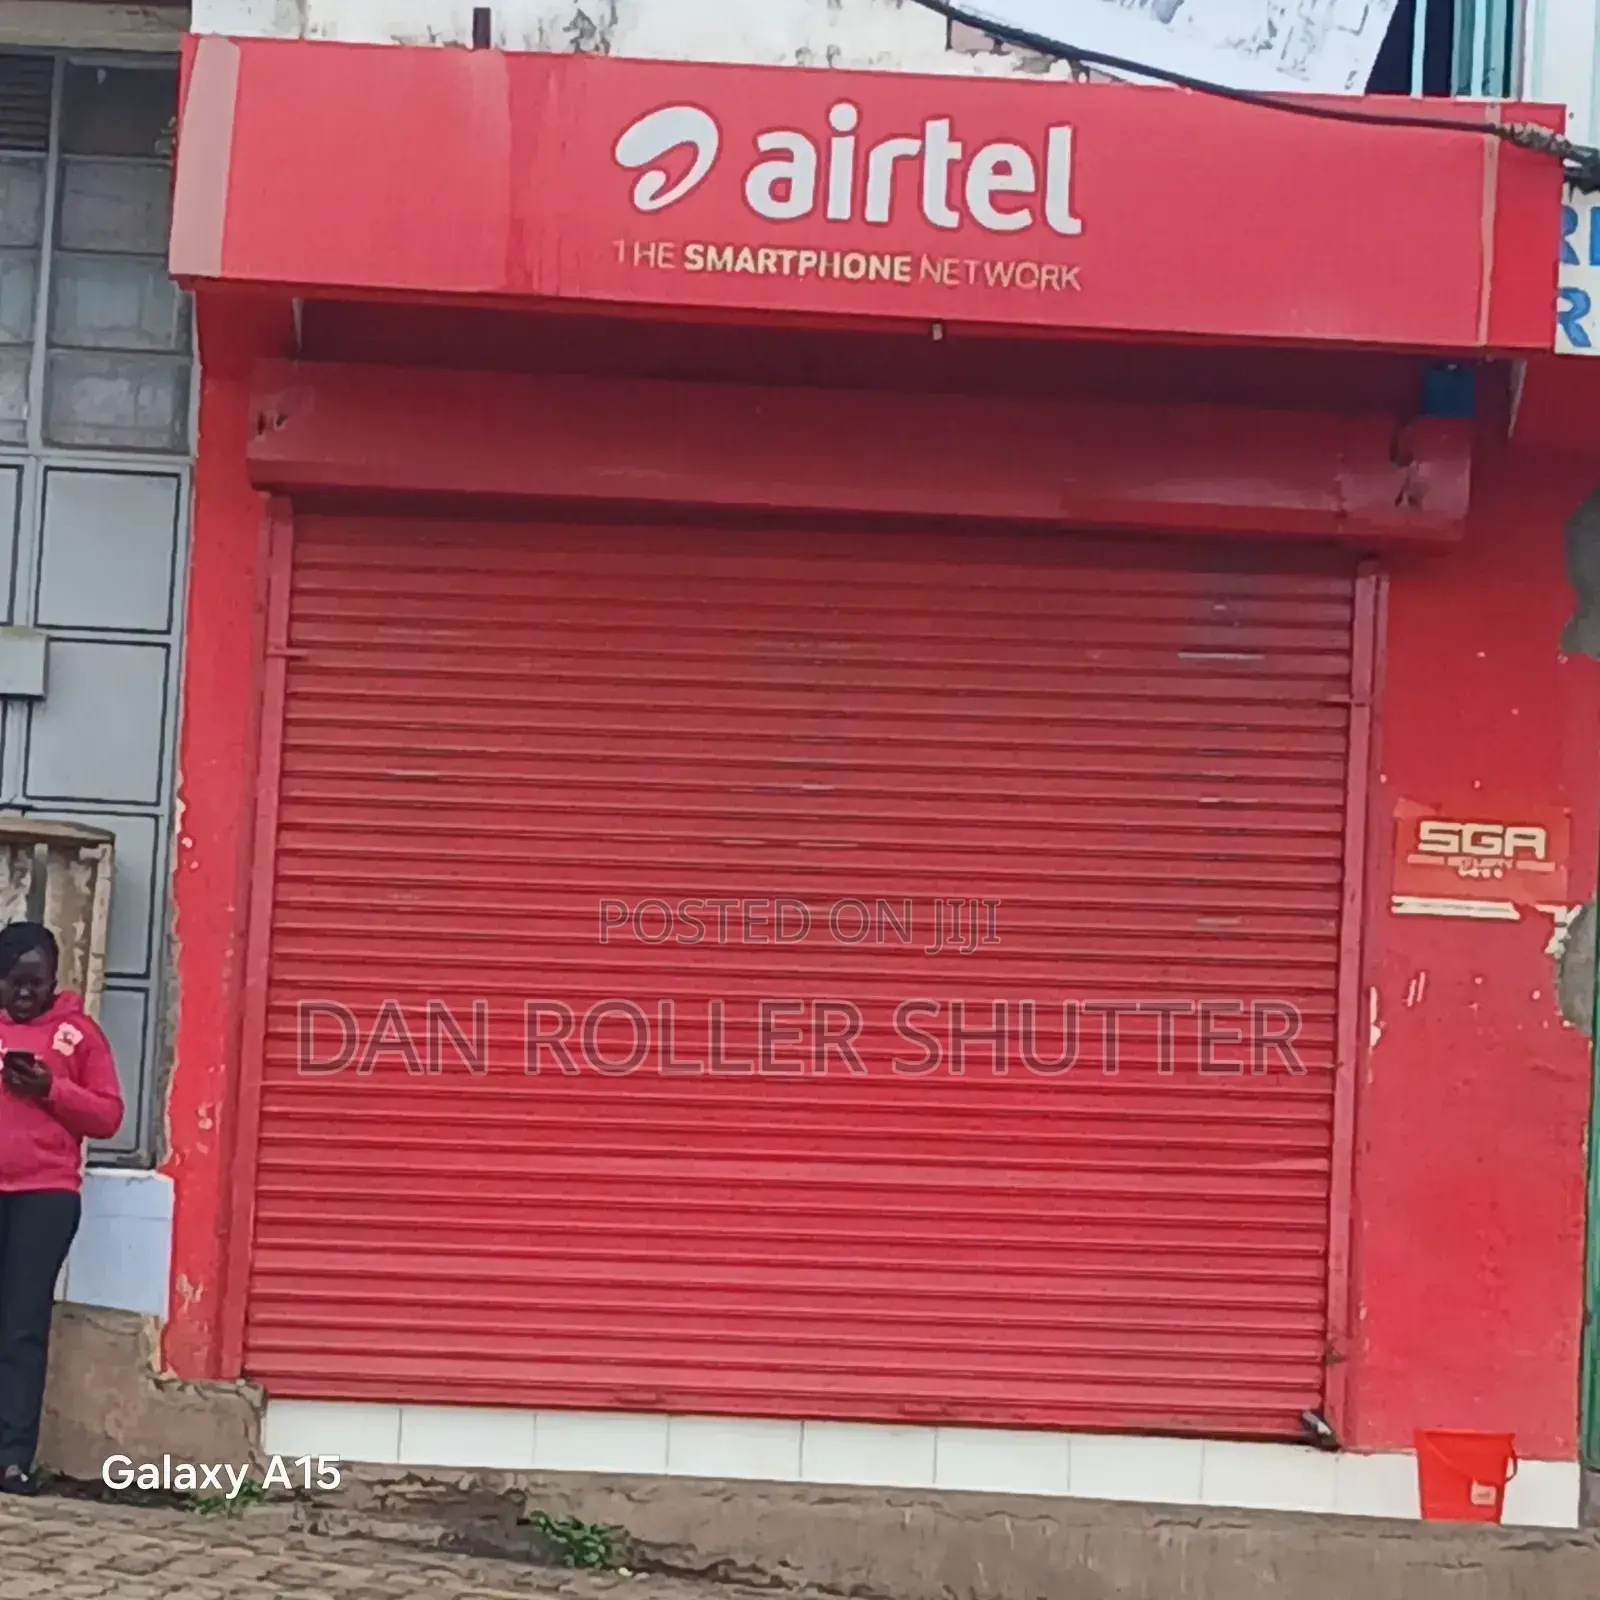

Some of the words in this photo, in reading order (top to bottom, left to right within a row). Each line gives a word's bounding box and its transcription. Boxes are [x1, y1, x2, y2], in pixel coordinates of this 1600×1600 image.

[744, 101, 1083, 236] airtel
[684, 243, 912, 284] SMARTPHONE
[919, 255, 1082, 292] NETWORK
[1418, 820, 1547, 860] SGA
